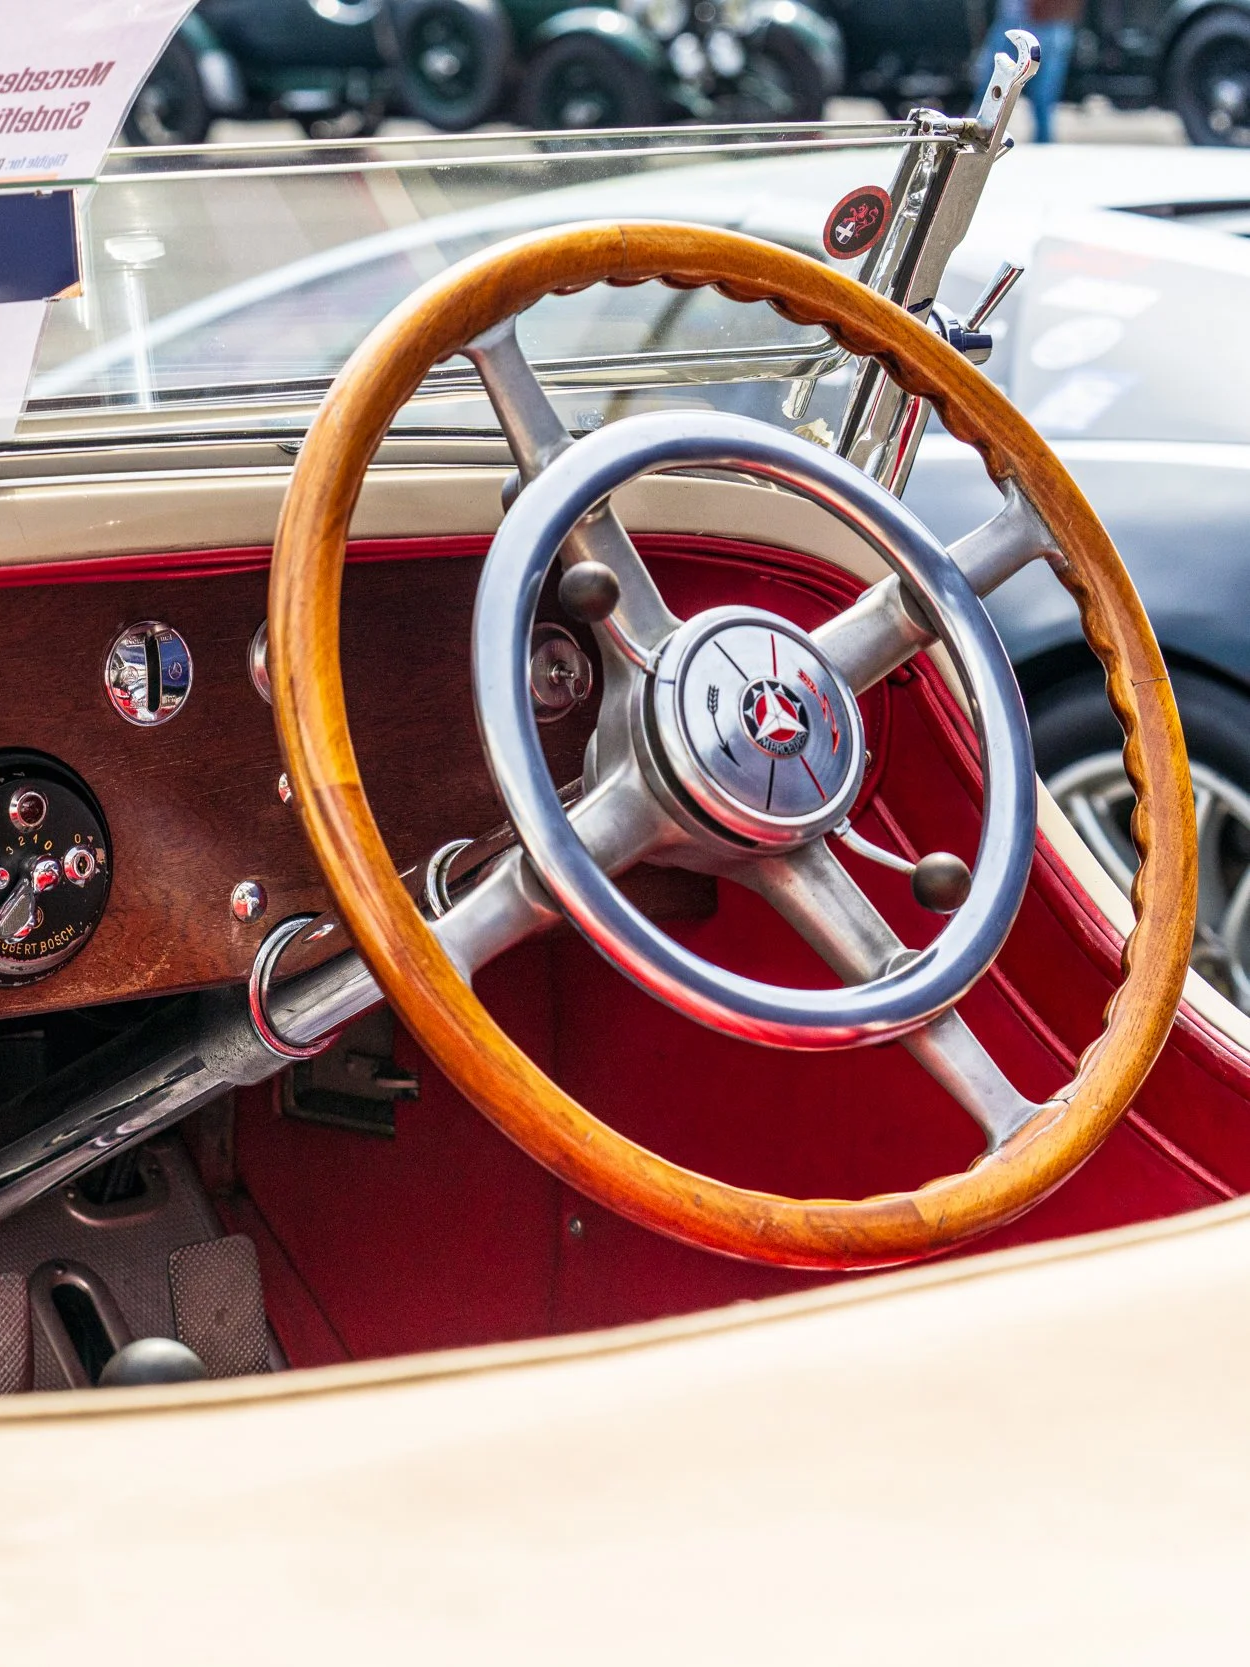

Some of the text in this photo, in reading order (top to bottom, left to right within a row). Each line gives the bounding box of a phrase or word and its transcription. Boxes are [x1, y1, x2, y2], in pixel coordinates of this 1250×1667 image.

[19, 836, 26, 848] 2
[74, 833, 81, 844] 0
[6, 846, 14, 855] 3
[44, 840, 53, 851] 0
[40, 924, 76, 954] BOSCH
